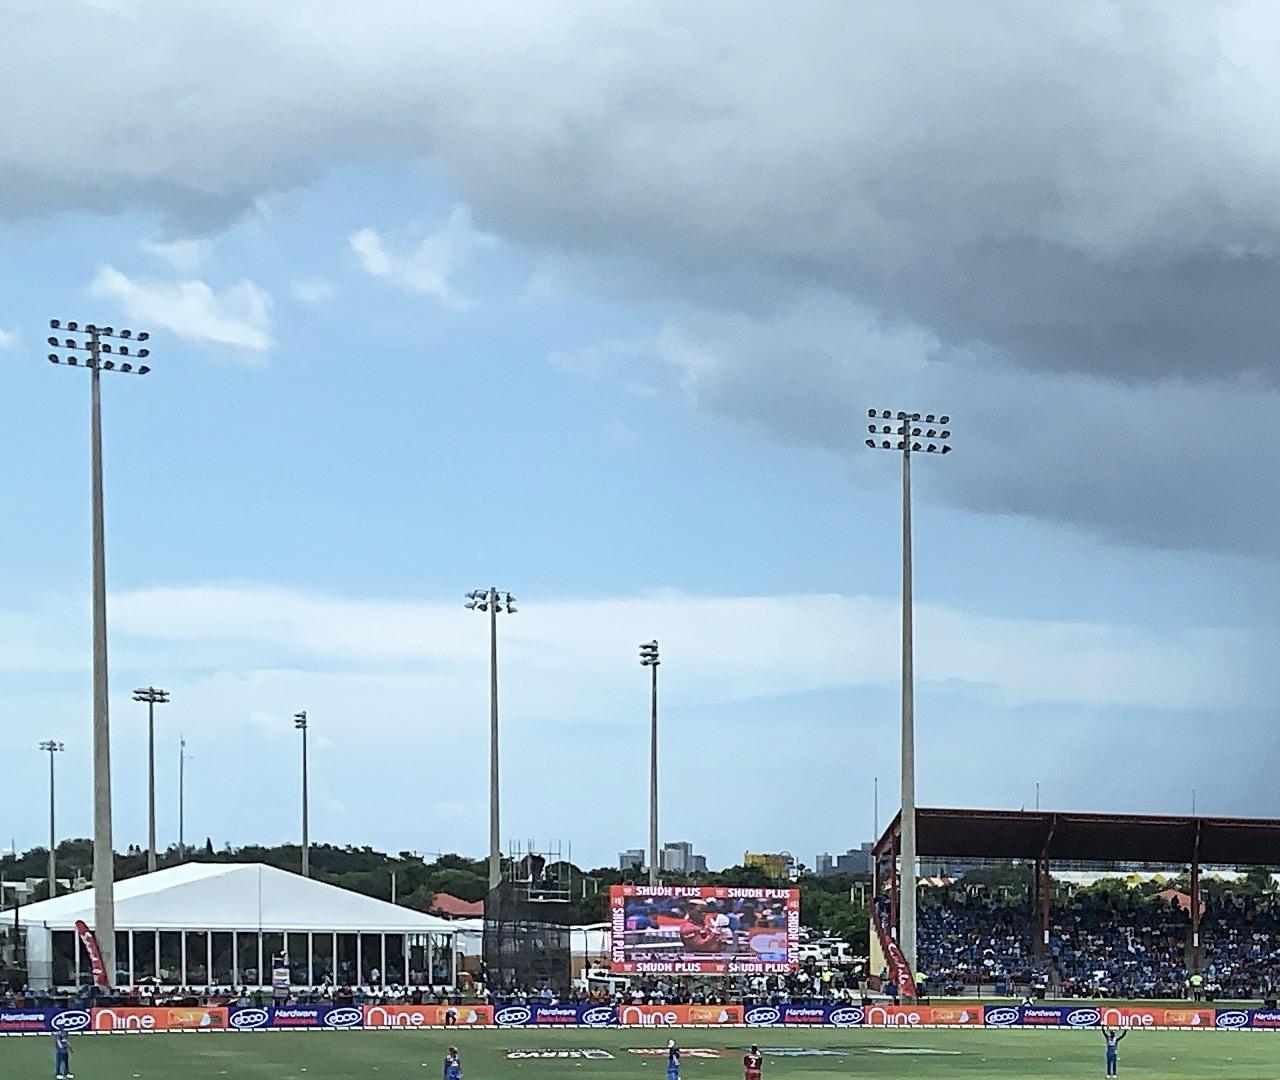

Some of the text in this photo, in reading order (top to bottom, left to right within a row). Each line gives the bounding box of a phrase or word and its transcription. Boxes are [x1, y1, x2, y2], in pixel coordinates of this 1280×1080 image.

[636, 887, 701, 897] SHUDH PLUS
[728, 888, 791, 898] SHUDH PLUS
[636, 963, 701, 972] SHUDH PLUS
[765, 964, 791, 973] PLUS
[1, 1013, 45, 1021] Hardware
[275, 1010, 318, 1018] Hardware
[750, 1058, 757, 1068] 2
